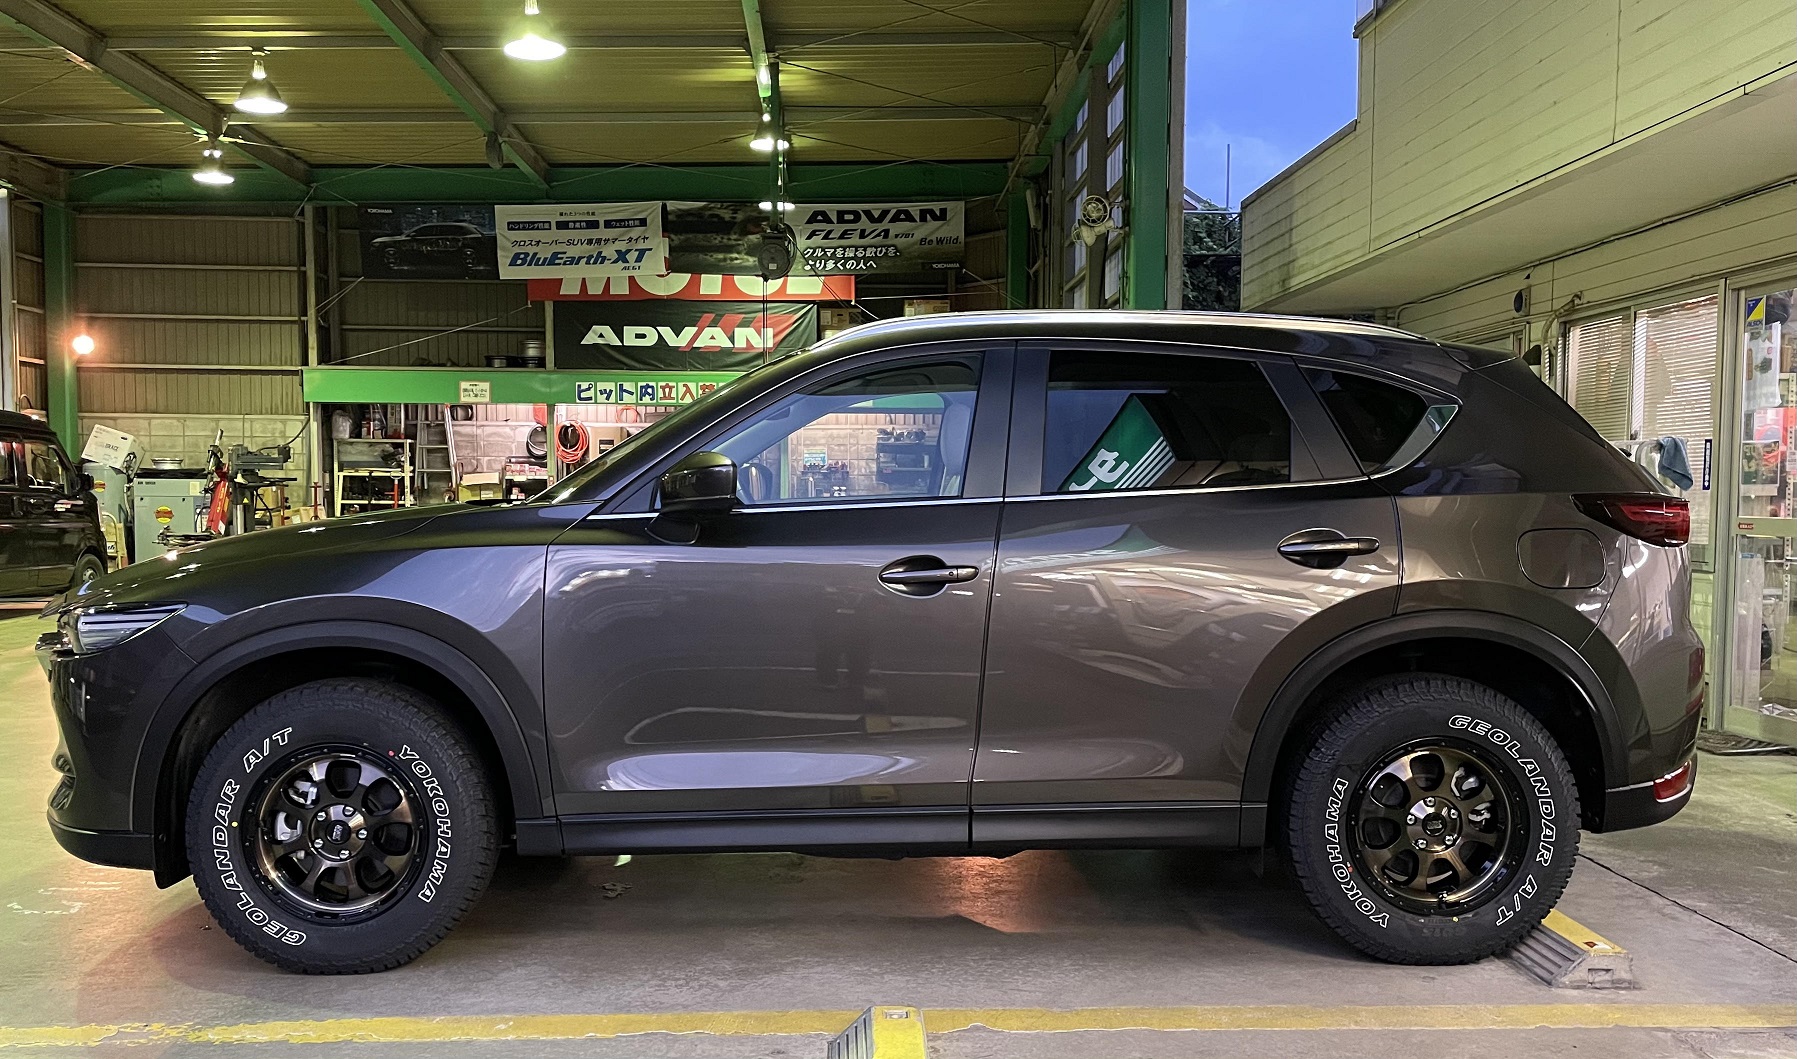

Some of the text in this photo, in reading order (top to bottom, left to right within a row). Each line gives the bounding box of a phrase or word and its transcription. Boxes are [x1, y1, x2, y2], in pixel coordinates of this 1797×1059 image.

[804, 208, 947, 224] ADVAN
[511, 236, 649, 248] クロスオーバーSUV専用サマータイヤ
[804, 228, 891, 241] FLEVA
[919, 236, 962, 246] Be Wild.
[508, 248, 653, 266] BluEarth-XT
[804, 260, 877, 271] より多くの人へ
[580, 325, 774, 348] ADVAN
[399, 745, 451, 903] YOKOHAMA
[1448, 714, 1556, 926] GEOLANDAR A/T
[212, 726, 306, 946] GEOLANDAR A/T
[1325, 777, 1389, 928] YOKOHAMA
